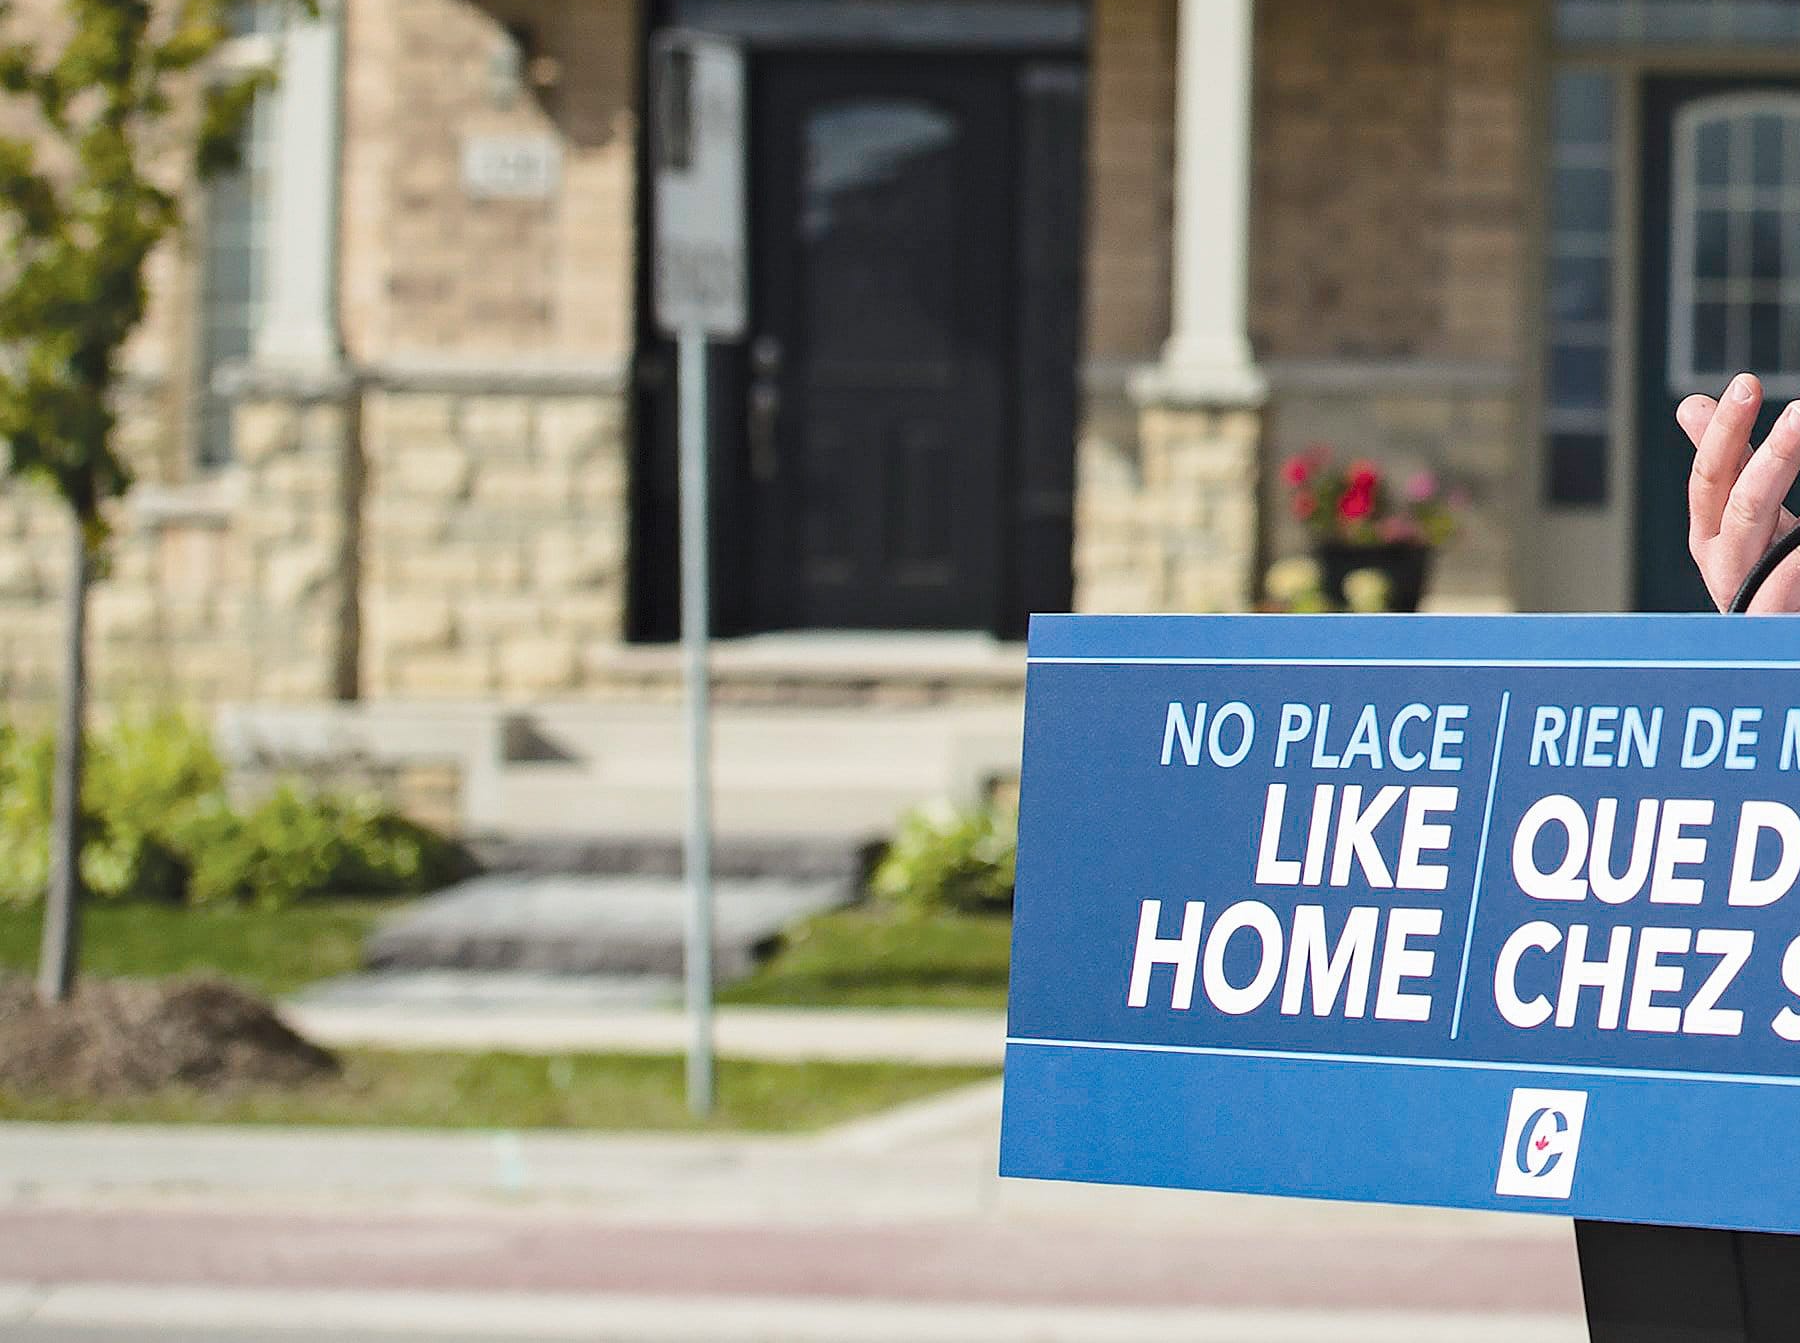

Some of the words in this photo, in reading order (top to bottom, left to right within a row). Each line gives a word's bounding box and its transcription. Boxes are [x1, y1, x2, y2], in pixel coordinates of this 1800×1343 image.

[1161, 702, 1254, 768] NO
[1275, 704, 1469, 772] PLACE
[1530, 707, 1664, 769] RIEN
[1681, 708, 1763, 771] DE
[1255, 784, 1460, 890] LIKE
[1512, 795, 1715, 905] QUE
[1128, 900, 1443, 1022] HOME
[1494, 921, 1755, 1036] CHEZ
